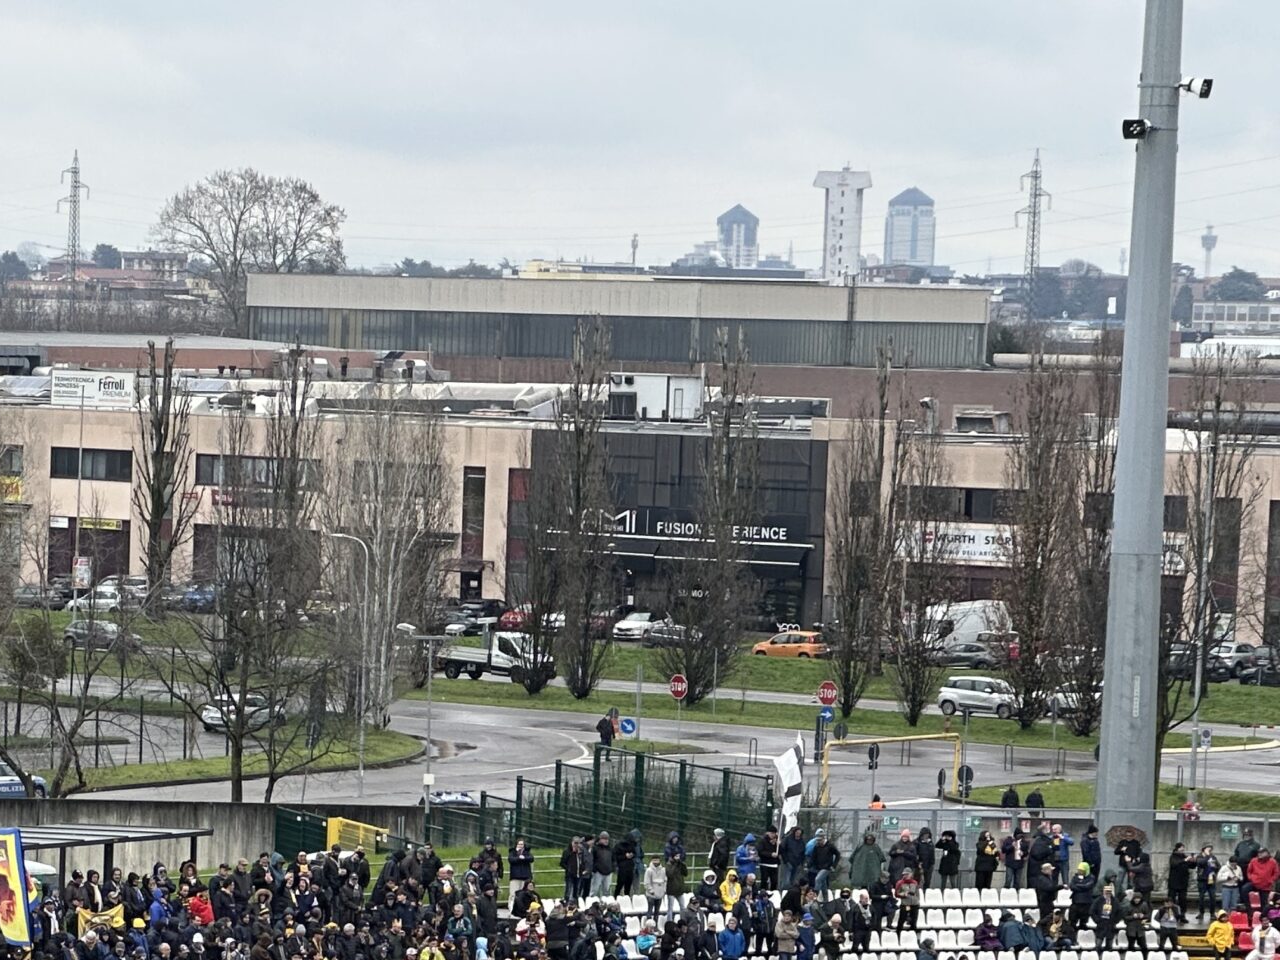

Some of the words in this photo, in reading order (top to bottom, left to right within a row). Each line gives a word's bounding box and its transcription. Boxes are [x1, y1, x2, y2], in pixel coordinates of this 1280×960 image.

[99, 378, 125, 392] Ferroli
[671, 682, 686, 692] STOP
[820, 688, 837, 698] STOP
